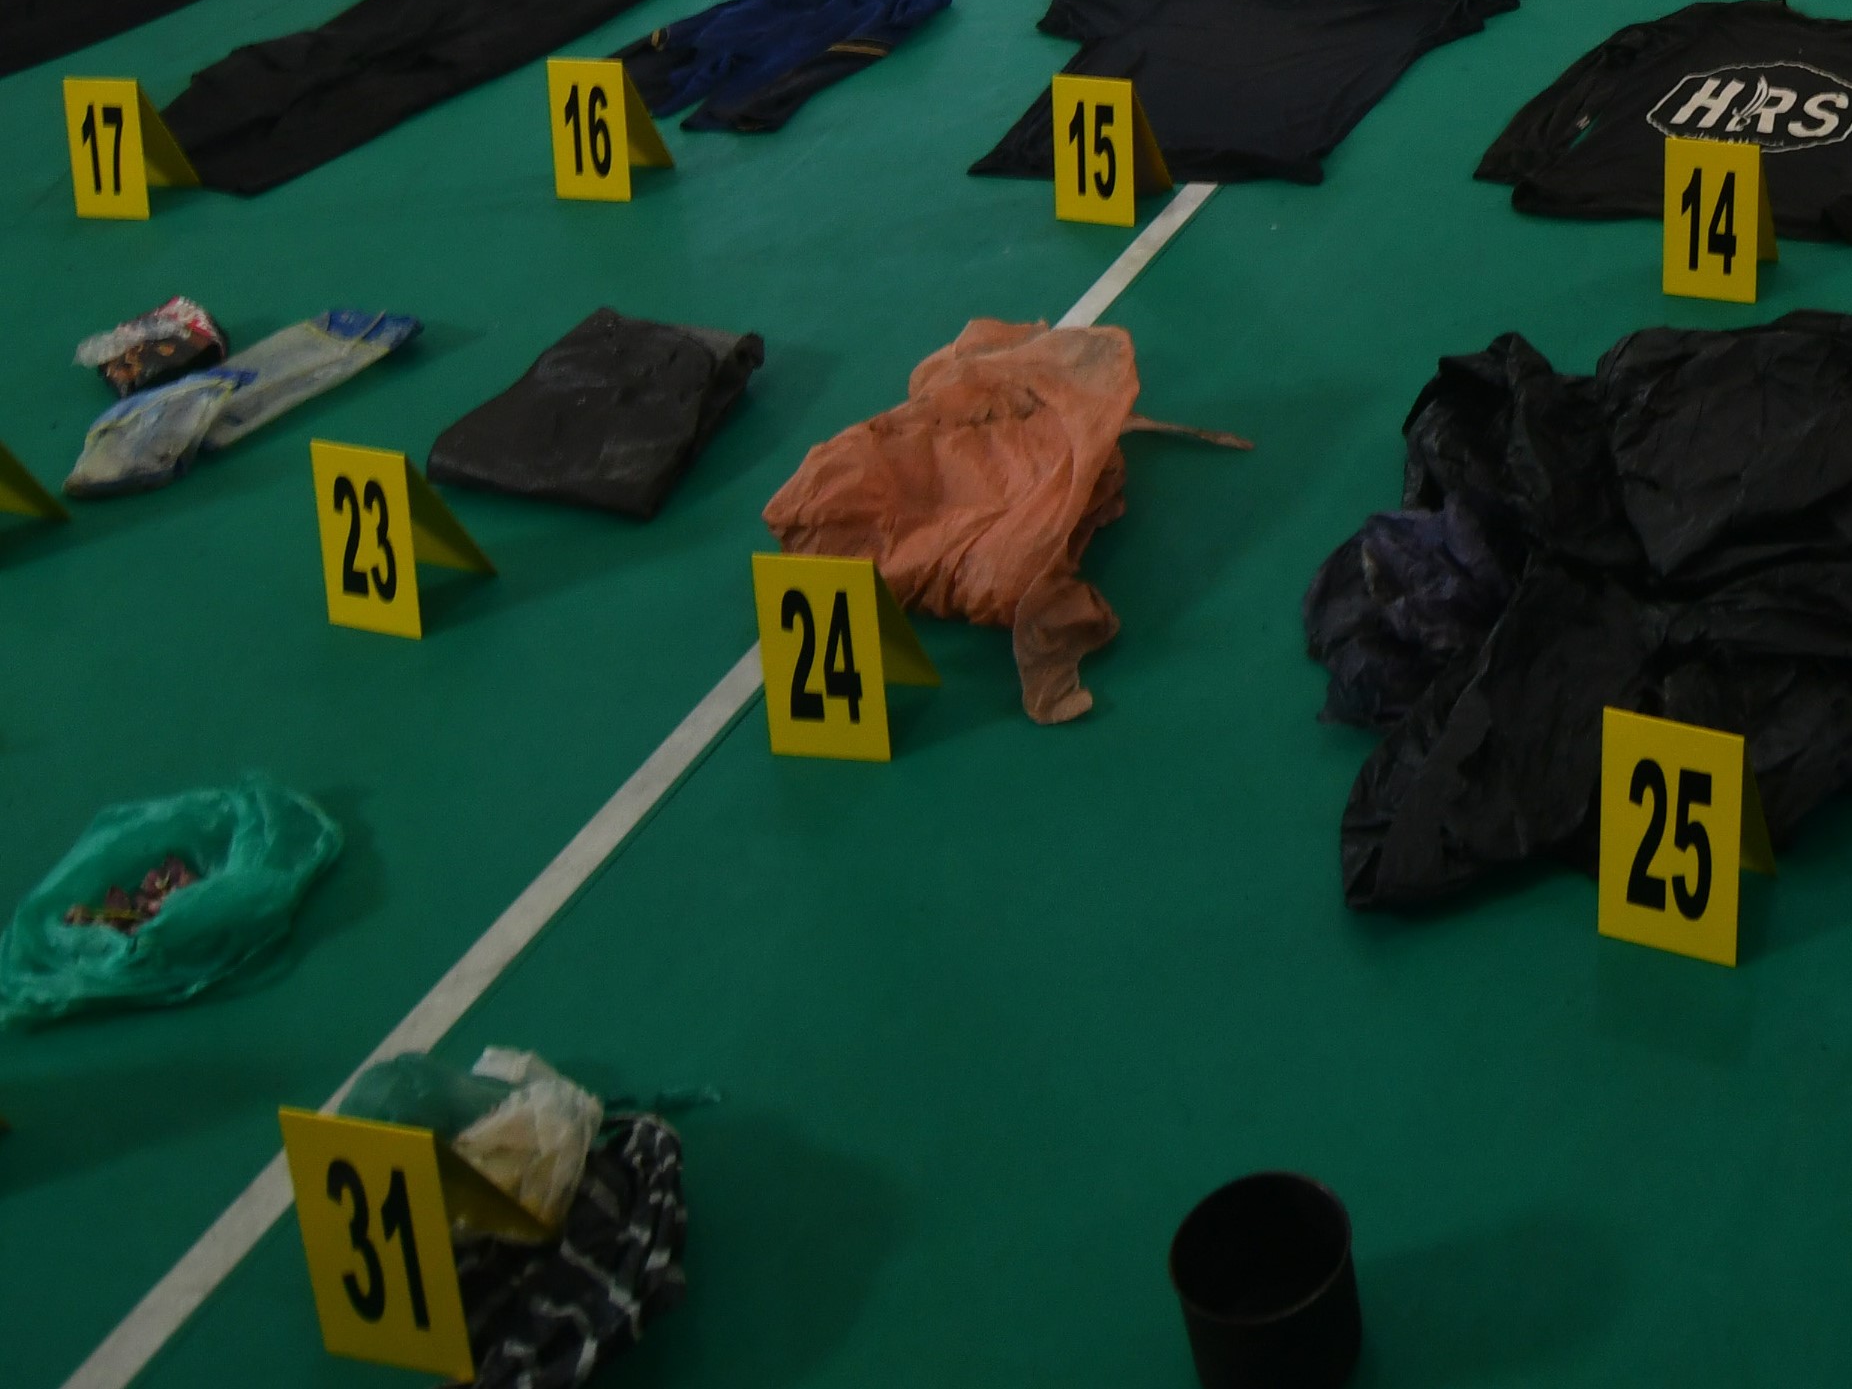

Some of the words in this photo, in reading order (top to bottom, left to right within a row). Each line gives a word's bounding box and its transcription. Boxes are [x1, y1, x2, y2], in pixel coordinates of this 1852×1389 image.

[82, 105, 123, 195] 17
[565, 85, 611, 177] 16
[1070, 102, 1116, 199] 15
[1682, 168, 1736, 275] 14
[334, 476, 396, 602] 23
[781, 589, 862, 724] 24
[1627, 759, 1712, 920] 25
[327, 1160, 430, 1331] 31
